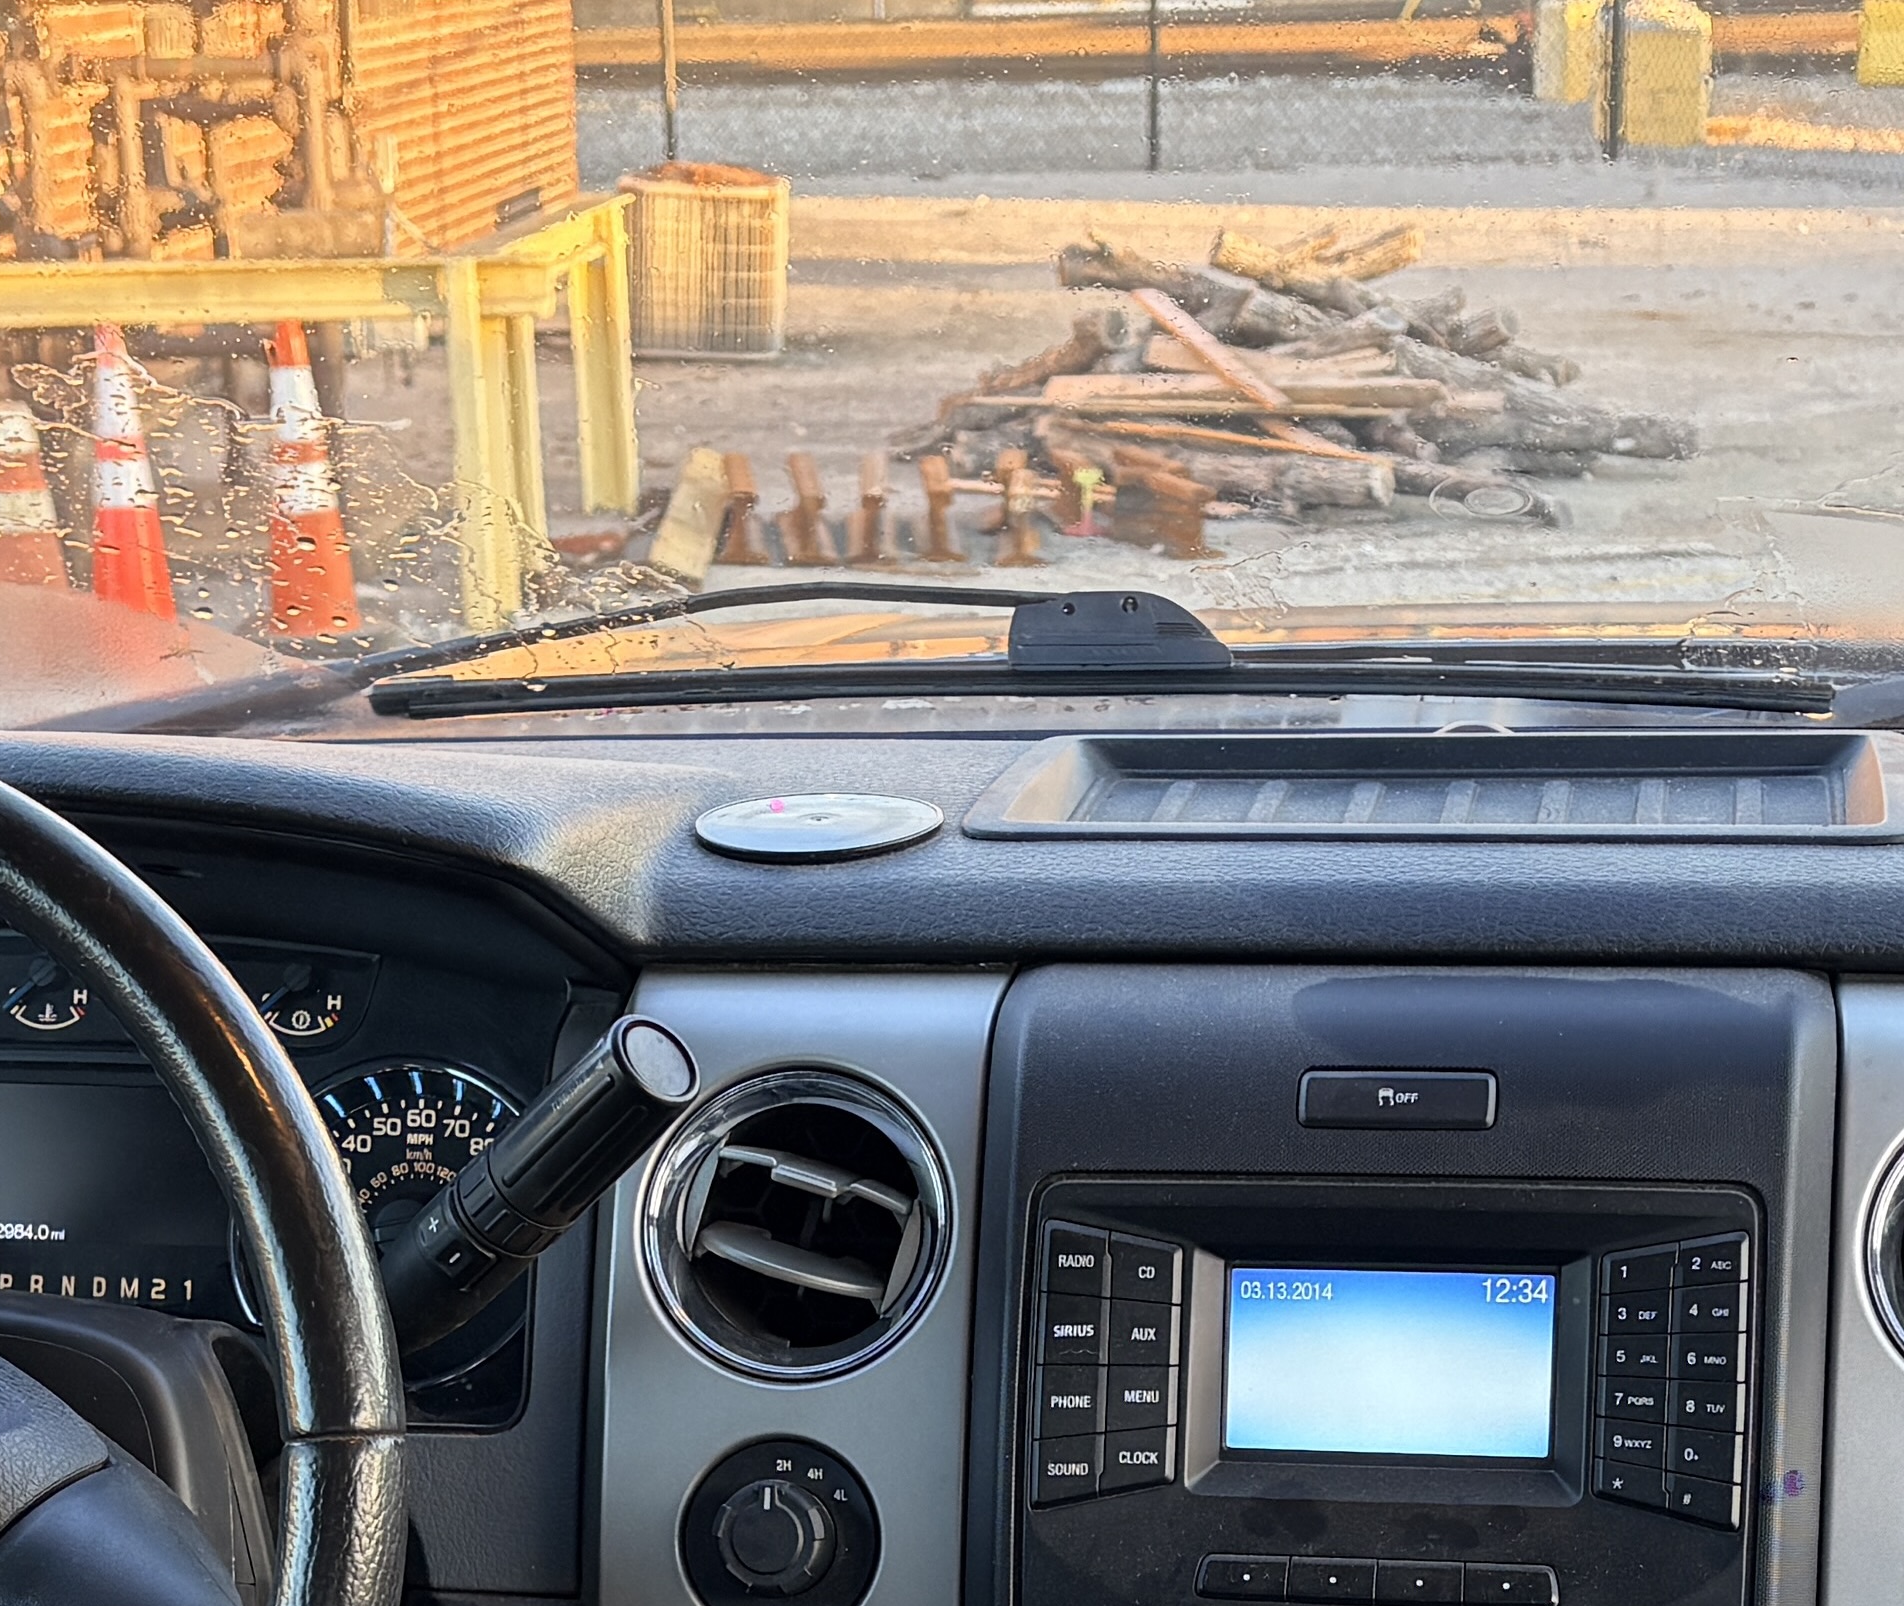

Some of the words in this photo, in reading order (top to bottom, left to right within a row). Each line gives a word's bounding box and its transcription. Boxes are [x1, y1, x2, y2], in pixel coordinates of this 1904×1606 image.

[74, 988, 88, 1004] H
[327, 994, 341, 1010] H
[1395, 1092, 1419, 1104] OFF
[407, 1109, 436, 1128] 60
[372, 1117, 402, 1136] 50
[442, 1119, 471, 1138] 70
[341, 1134, 372, 1153] 40
[406, 1133, 434, 1146] MPH
[391, 1162, 409, 1177] 80
[414, 1162, 436, 1175] 100
[436, 1165, 458, 1183] 120
[370, 1172, 388, 1189] 60
[1058, 1254, 1095, 1268] RADIO
[1691, 1257, 1701, 1270] 2
[1138, 1266, 1156, 1279] CD
[1620, 1265, 1628, 1278] 1
[62, 1275, 75, 1297] N
[92, 1276, 107, 1297] D
[120, 1277, 139, 1299] M
[150, 1278, 166, 1300] 2
[1239, 1280, 1334, 1301] 03.13.2014
[1481, 1278, 1549, 1304] 12:34
[1617, 1307, 1627, 1320] 3
[1689, 1303, 1698, 1316] 4
[1053, 1324, 1095, 1337] SIRIUS
[1131, 1327, 1156, 1341] AUX
[1616, 1350, 1626, 1362] 5
[1687, 1352, 1696, 1365] 6
[1703, 1356, 1727, 1365] MNO
[1050, 1395, 1092, 1408] PHONE
[1124, 1390, 1159, 1403] MENU
[1614, 1393, 1624, 1406] 7
[1685, 1400, 1695, 1413] 8
[1706, 1404, 1726, 1413] TUV
[1613, 1435, 1622, 1447] 9
[1623, 1440, 1652, 1449] WXYZ
[1118, 1451, 1158, 1464] CLOCK
[776, 1459, 792, 1472] 2H
[1047, 1463, 1089, 1476] SOUND
[807, 1468, 823, 1480] 4H
[833, 1489, 848, 1501] 4L
